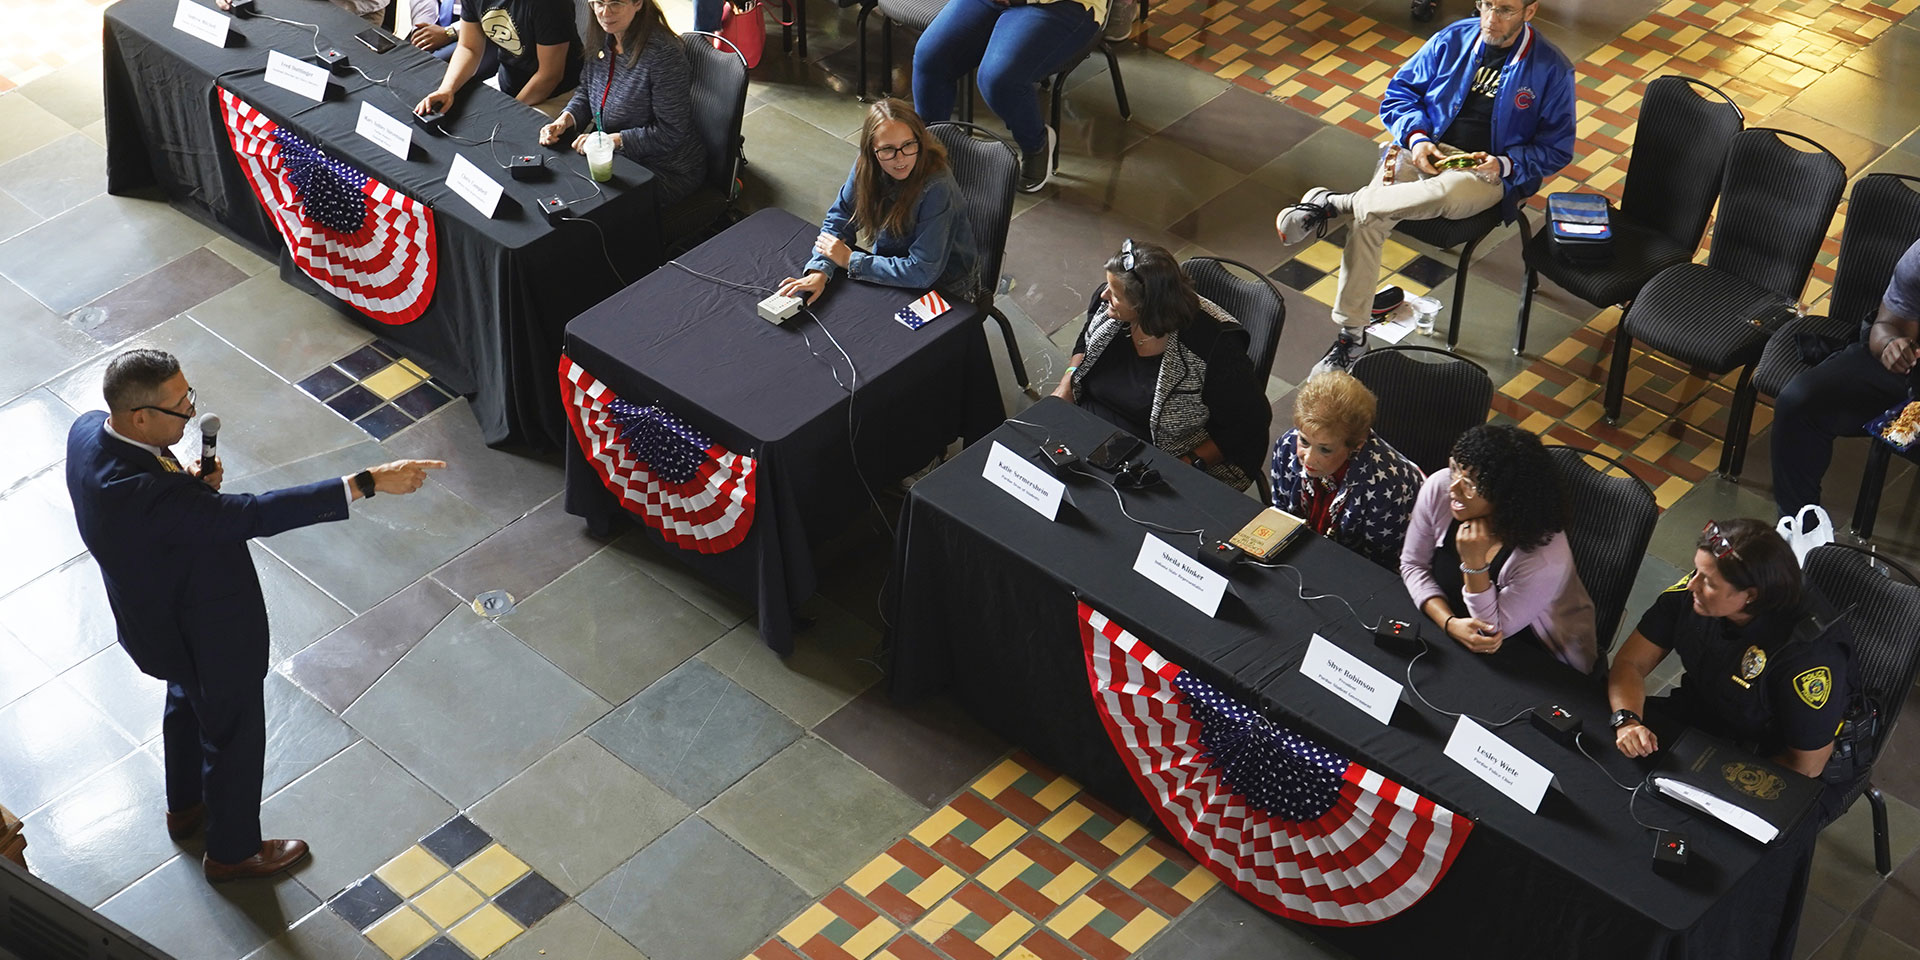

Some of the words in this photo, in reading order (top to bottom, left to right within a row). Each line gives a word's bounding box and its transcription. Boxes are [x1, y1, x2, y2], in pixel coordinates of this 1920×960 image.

[998, 461, 1012, 473] Katie
[1014, 471, 1049, 497] Sermersheim
[1162, 552, 1181, 567] Sheila
[1181, 563, 1204, 581] Klinker
[1327, 659, 1343, 672] Shye
[1343, 669, 1375, 693] Robinson
[1477, 745, 1498, 764] Lesley
[1500, 760, 1519, 776] Wiete
